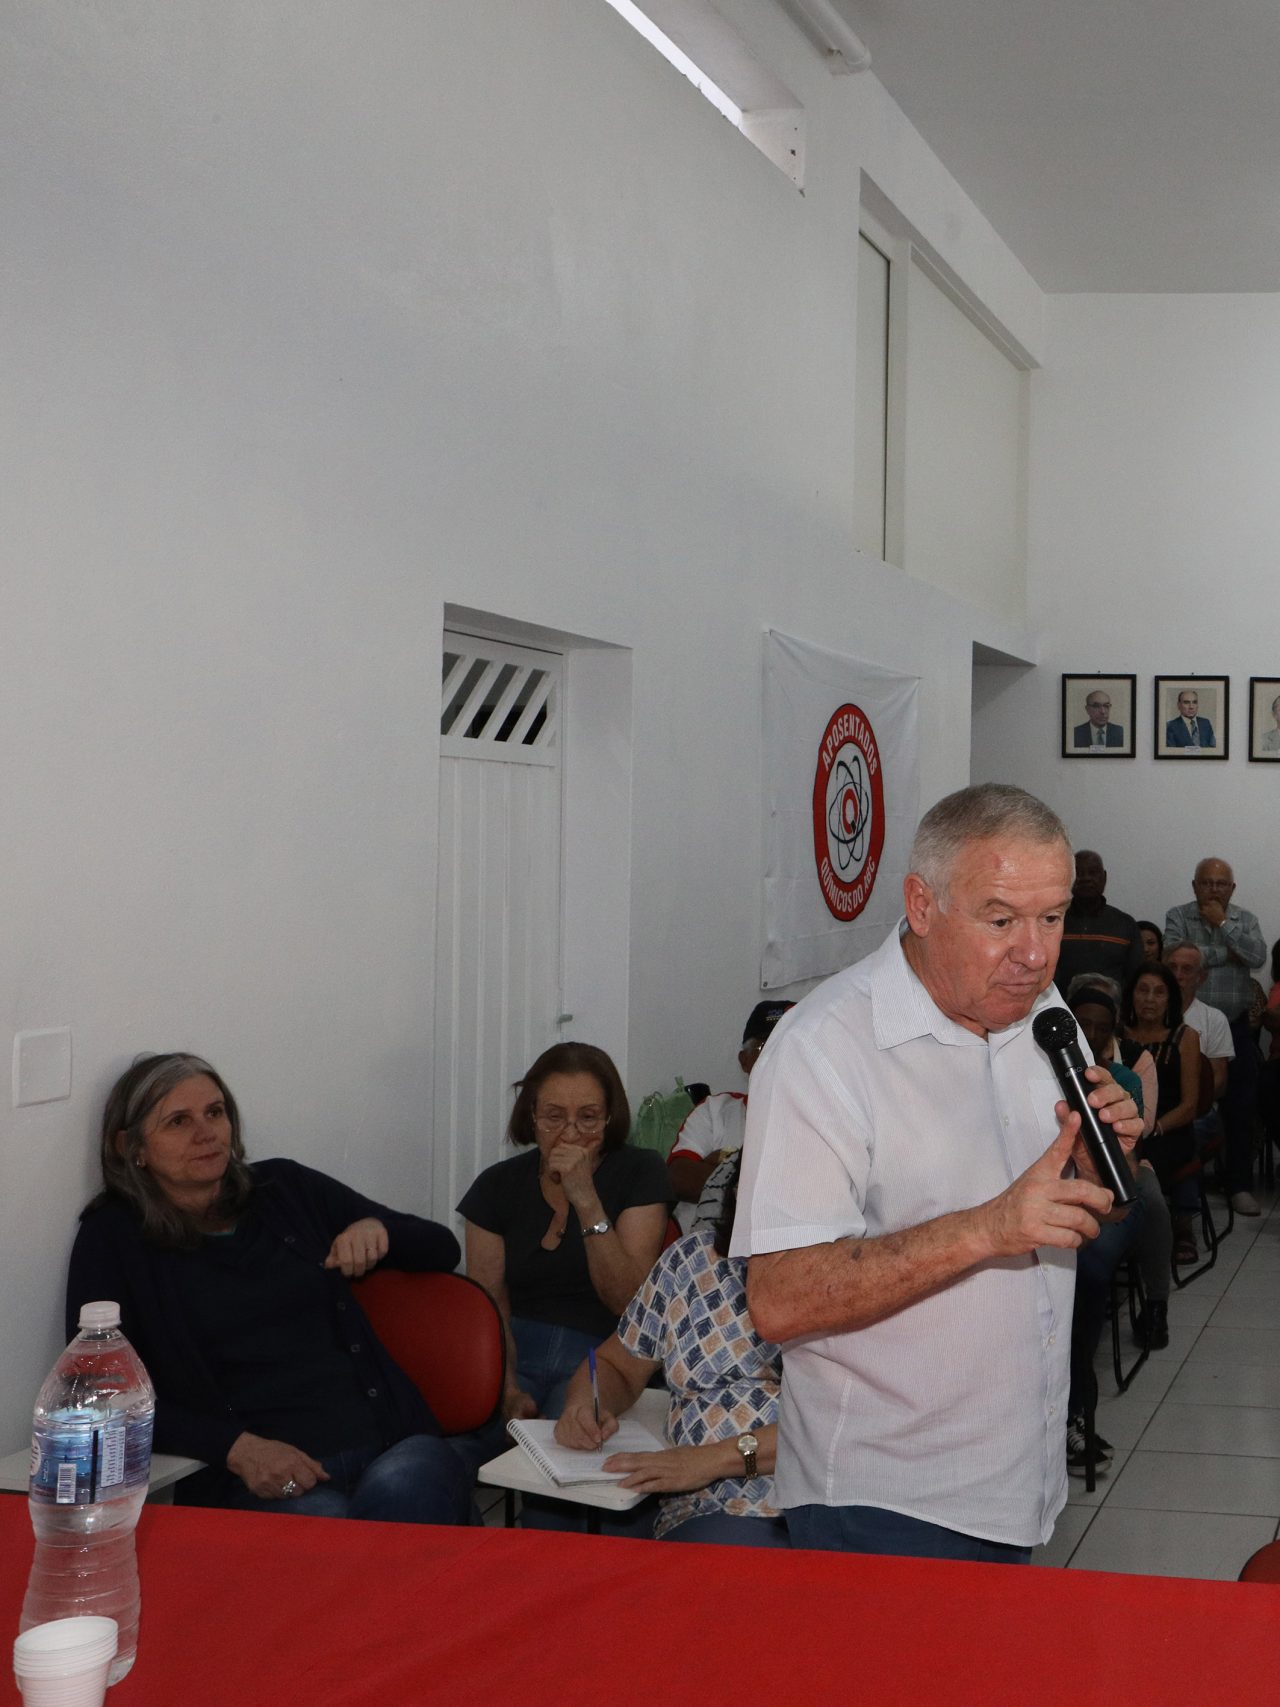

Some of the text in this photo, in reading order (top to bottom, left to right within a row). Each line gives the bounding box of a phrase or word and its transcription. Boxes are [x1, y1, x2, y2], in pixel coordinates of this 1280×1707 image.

[822, 713, 878, 776] APOSENTADOS
[852, 884, 864, 909] DO
[863, 855, 875, 894] ABC
